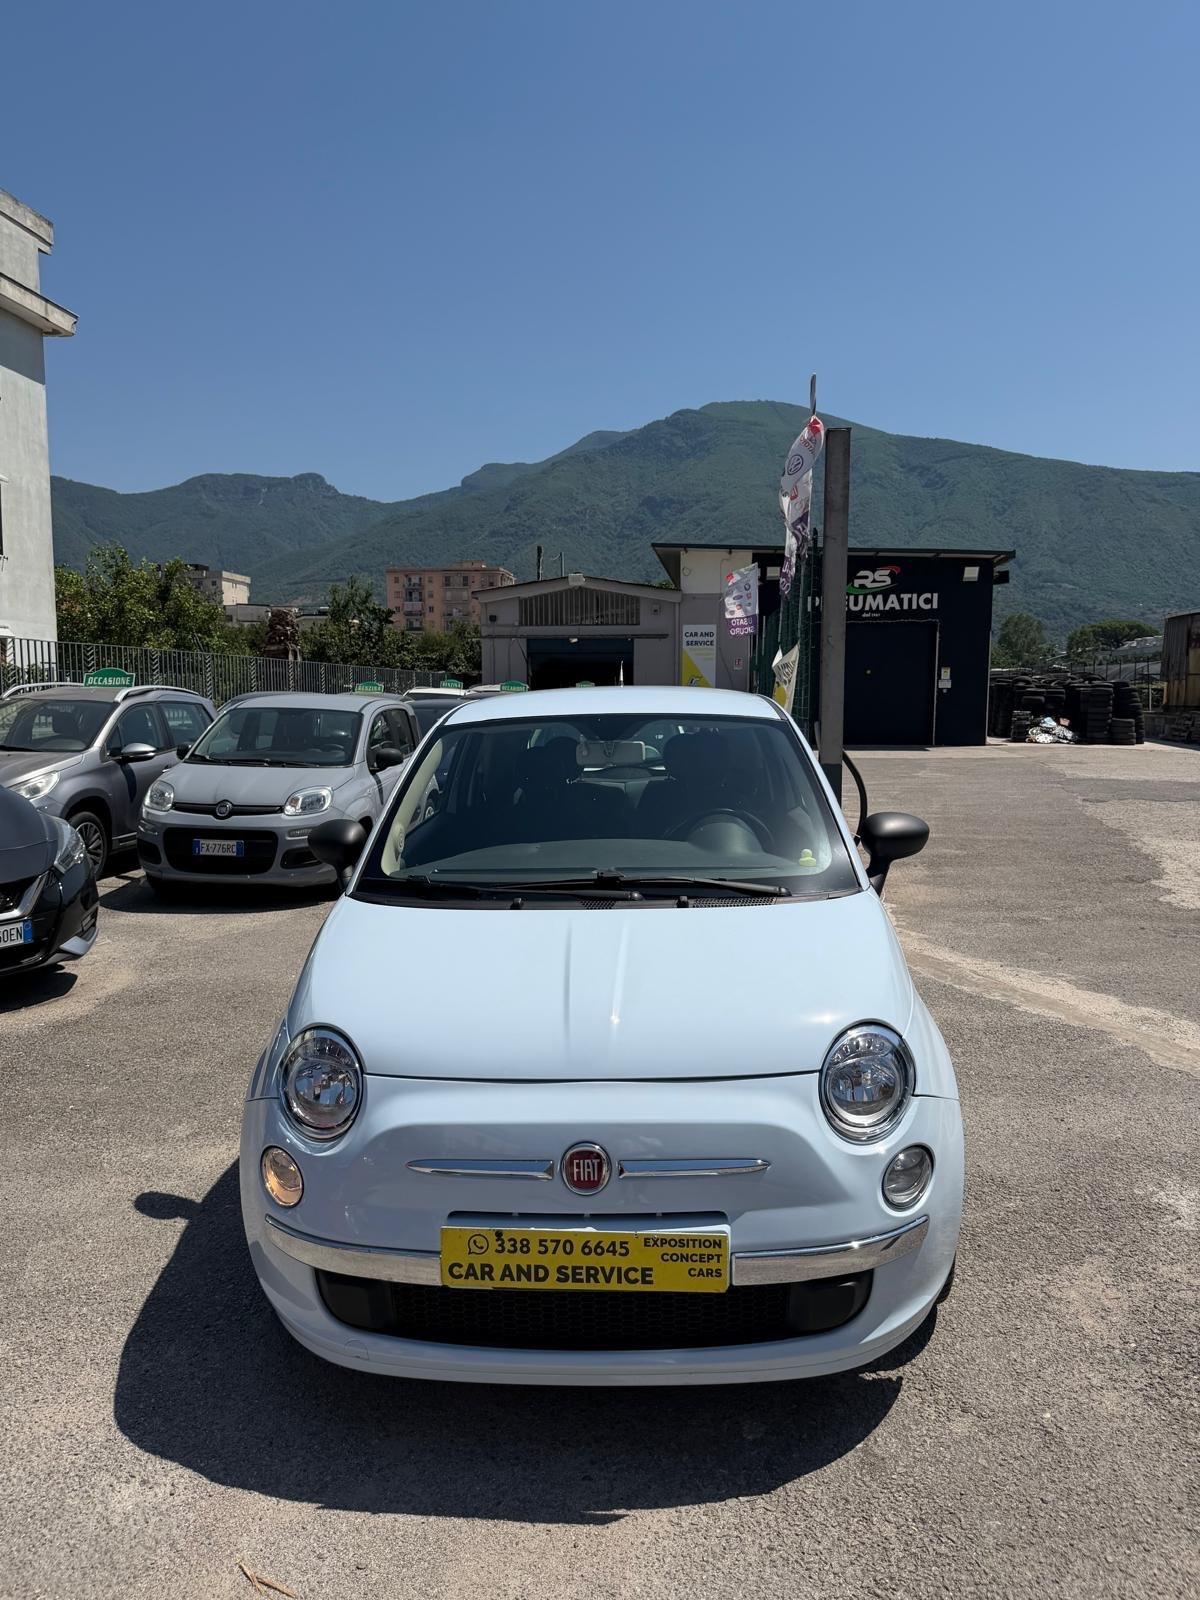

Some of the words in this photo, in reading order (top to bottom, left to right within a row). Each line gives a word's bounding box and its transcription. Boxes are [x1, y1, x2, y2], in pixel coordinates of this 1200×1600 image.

[853, 569, 892, 589] RS
[807, 593, 939, 612] PUMATICI
[87, 676, 131, 686] OCCASIONE
[573, 1159, 601, 1182] FIAT
[494, 1237, 531, 1255] 338
[537, 1239, 574, 1256] 570
[580, 1240, 630, 1257] 6645
[643, 1237, 722, 1249] EXPOSITION
[660, 1252, 722, 1264] CONCEPT
[448, 1262, 495, 1281] CAR
[499, 1263, 550, 1283] AND
[555, 1265, 654, 1285] SERVICE
[687, 1267, 722, 1278] CARS
